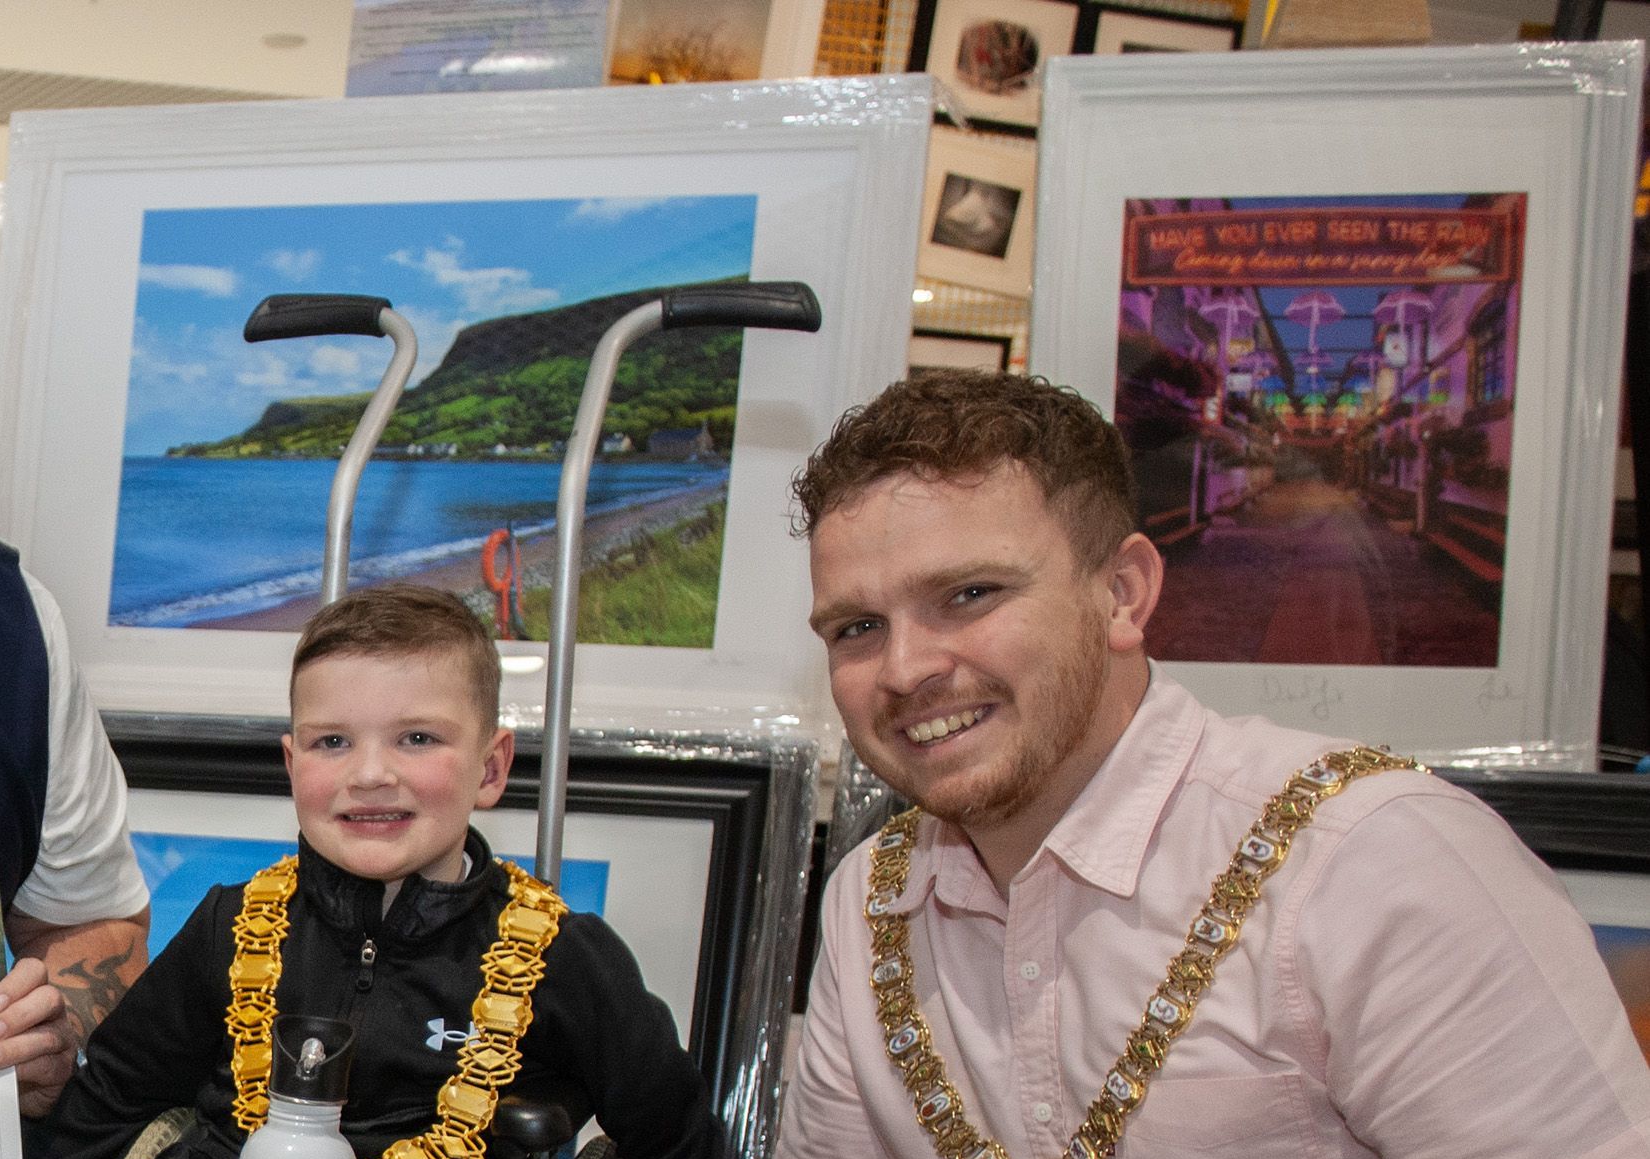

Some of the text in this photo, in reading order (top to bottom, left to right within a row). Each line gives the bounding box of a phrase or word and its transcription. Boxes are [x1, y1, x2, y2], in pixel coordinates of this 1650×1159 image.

[1149, 221, 1490, 249] HAVE YOU EVER SEEN THE RAIN
